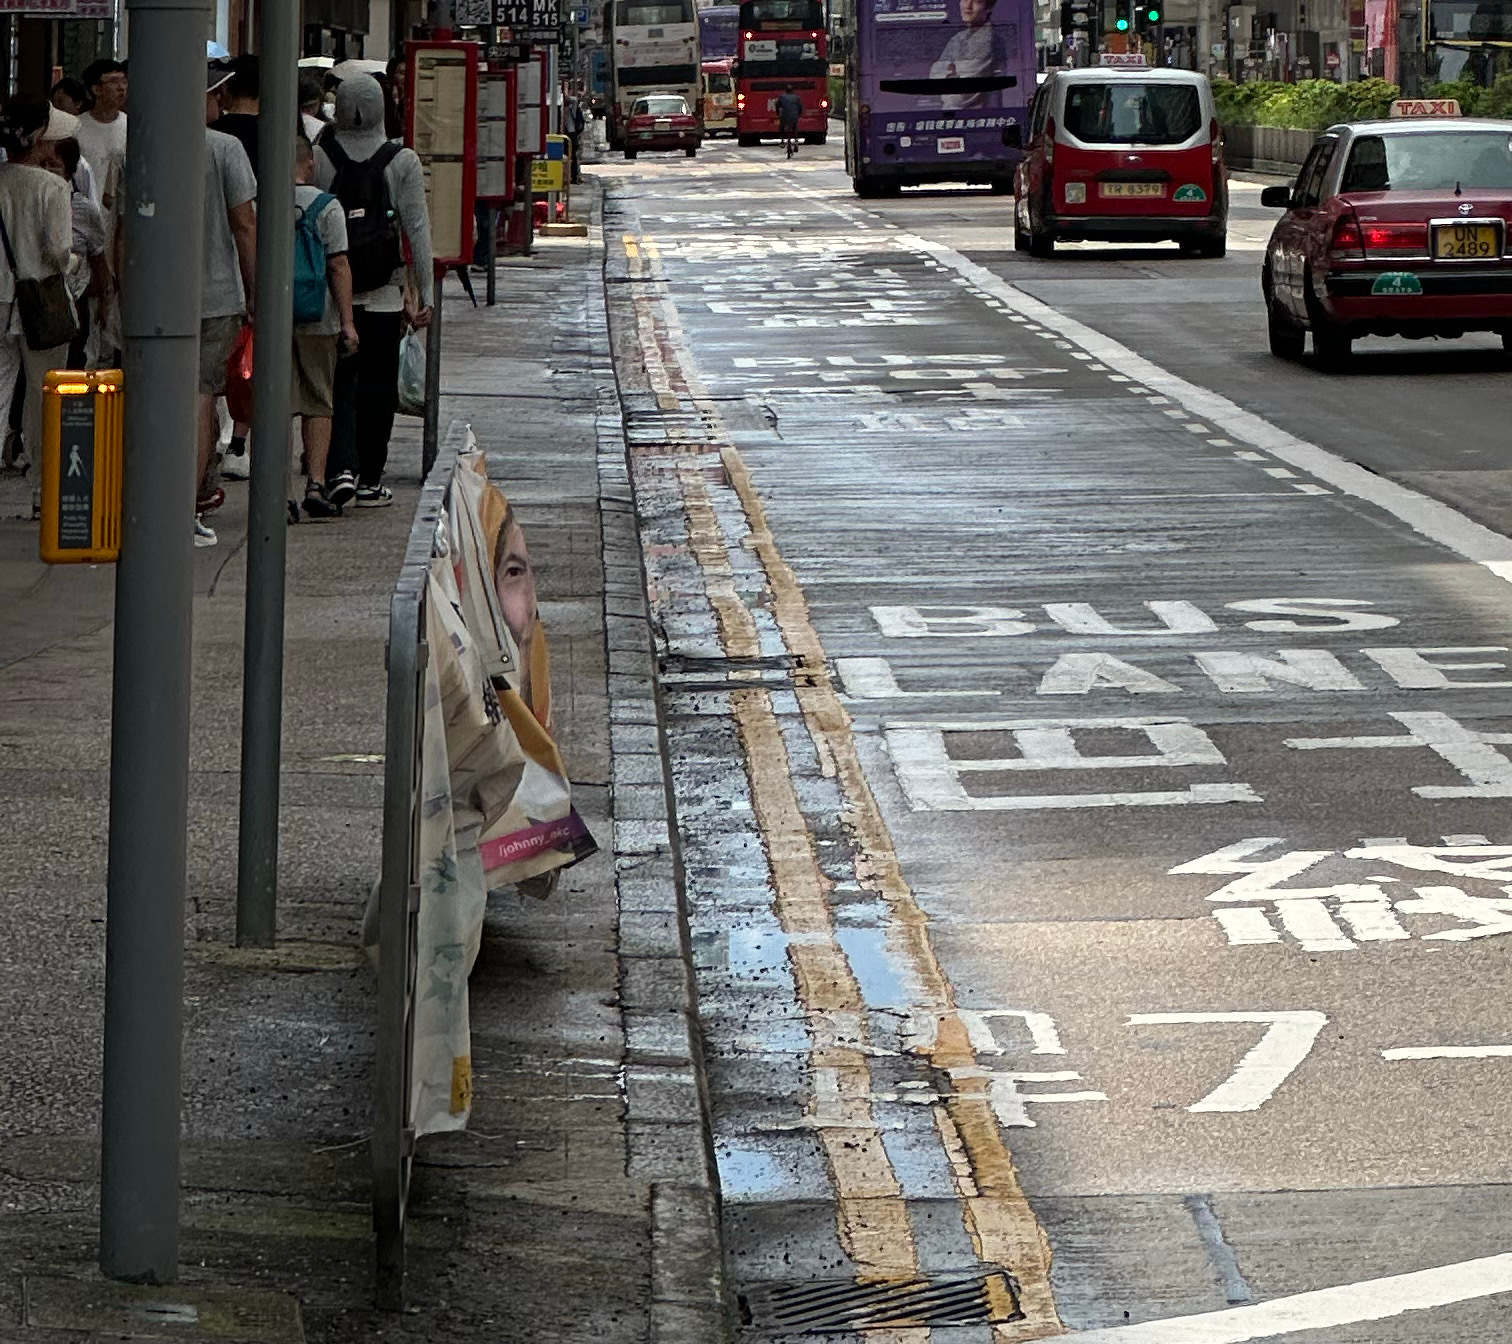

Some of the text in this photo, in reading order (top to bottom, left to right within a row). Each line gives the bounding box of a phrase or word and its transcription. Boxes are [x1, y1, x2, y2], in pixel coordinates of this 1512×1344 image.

[533, 0, 557, 12] MK
[496, 7, 528, 23] 514
[532, 13, 558, 26] 515
[1104, 55, 1143, 64] TAXI
[1396, 101, 1455, 116] TAXI
[1443, 242, 1490, 258] 2489
[1392, 276, 1402, 287] 4
[870, 597, 1400, 637] BUS
[1127, 1010, 1330, 1114] 7
